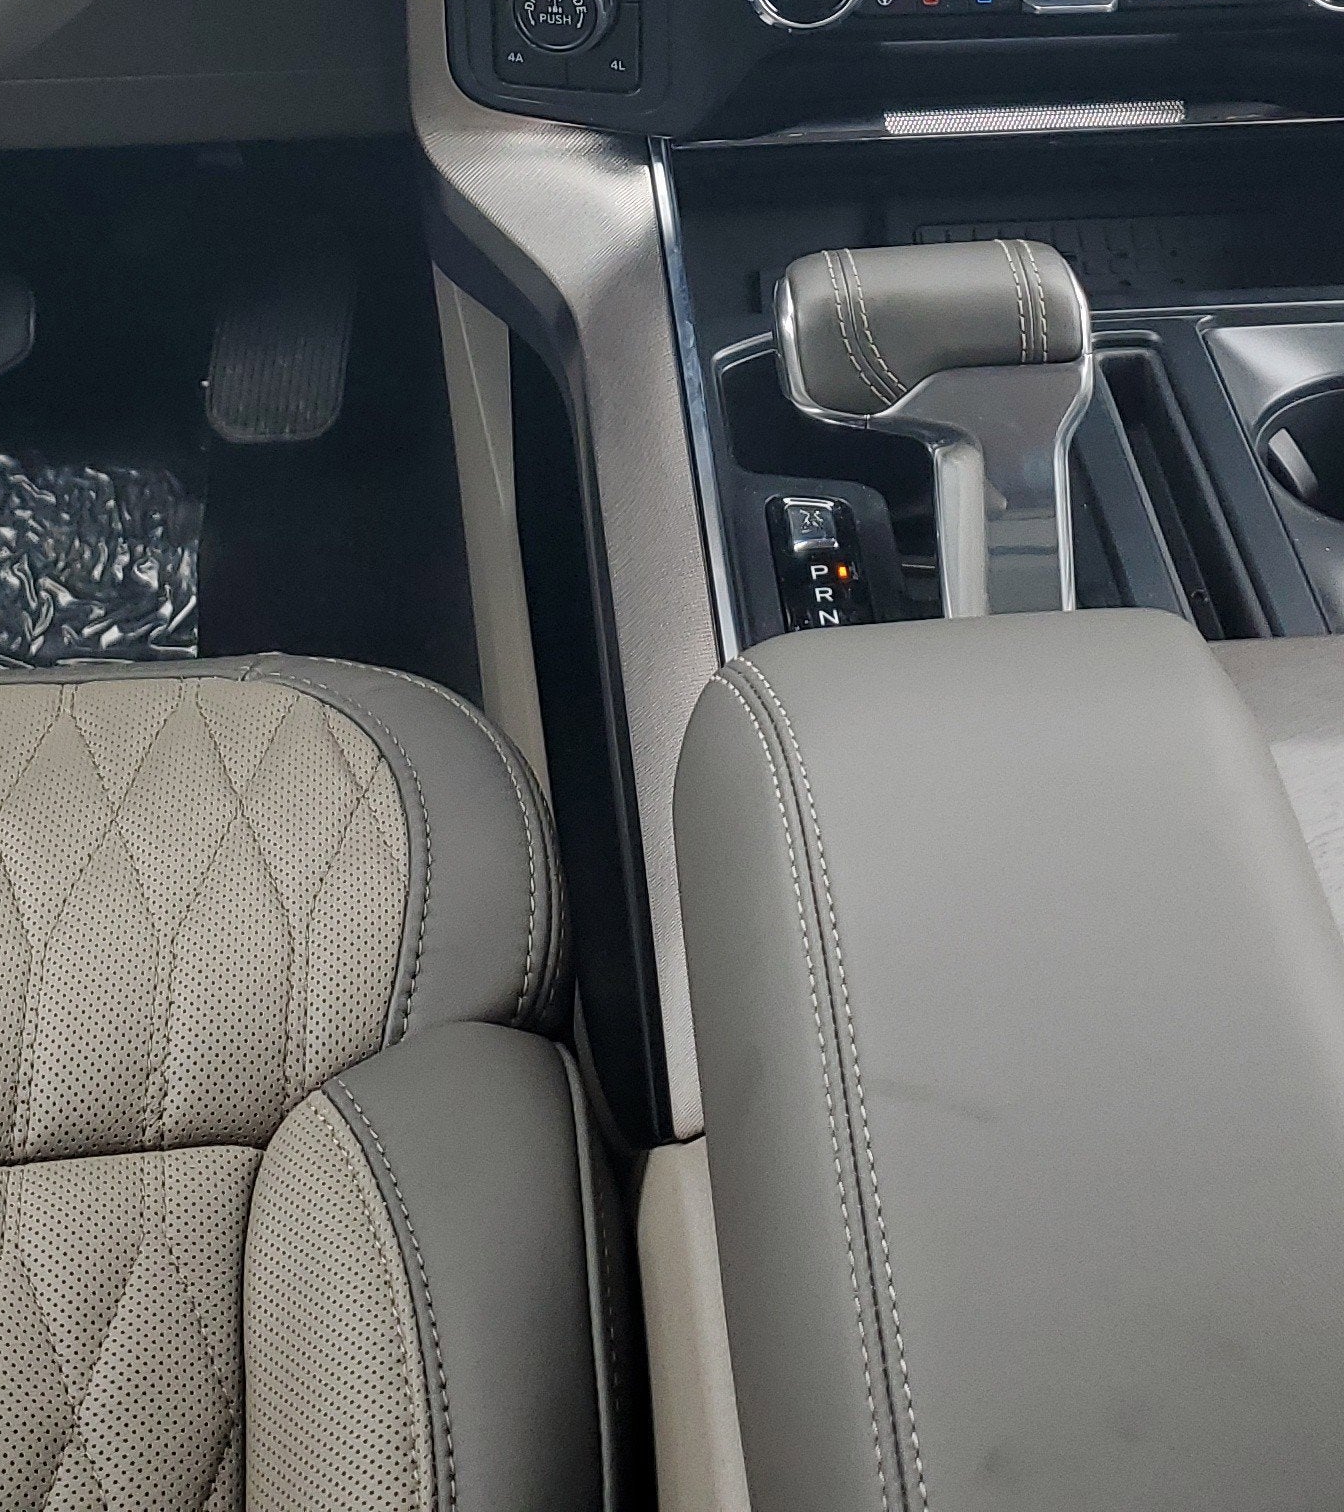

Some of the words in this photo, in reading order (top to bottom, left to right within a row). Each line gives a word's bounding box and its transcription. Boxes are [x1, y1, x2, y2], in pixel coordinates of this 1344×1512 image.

[539, 13, 572, 25] PUSH
[508, 52, 524, 64] 4A
[610, 60, 625, 71] 4L
[810, 565, 828, 580] P
[814, 587, 834, 602] R
[818, 609, 840, 626] N
